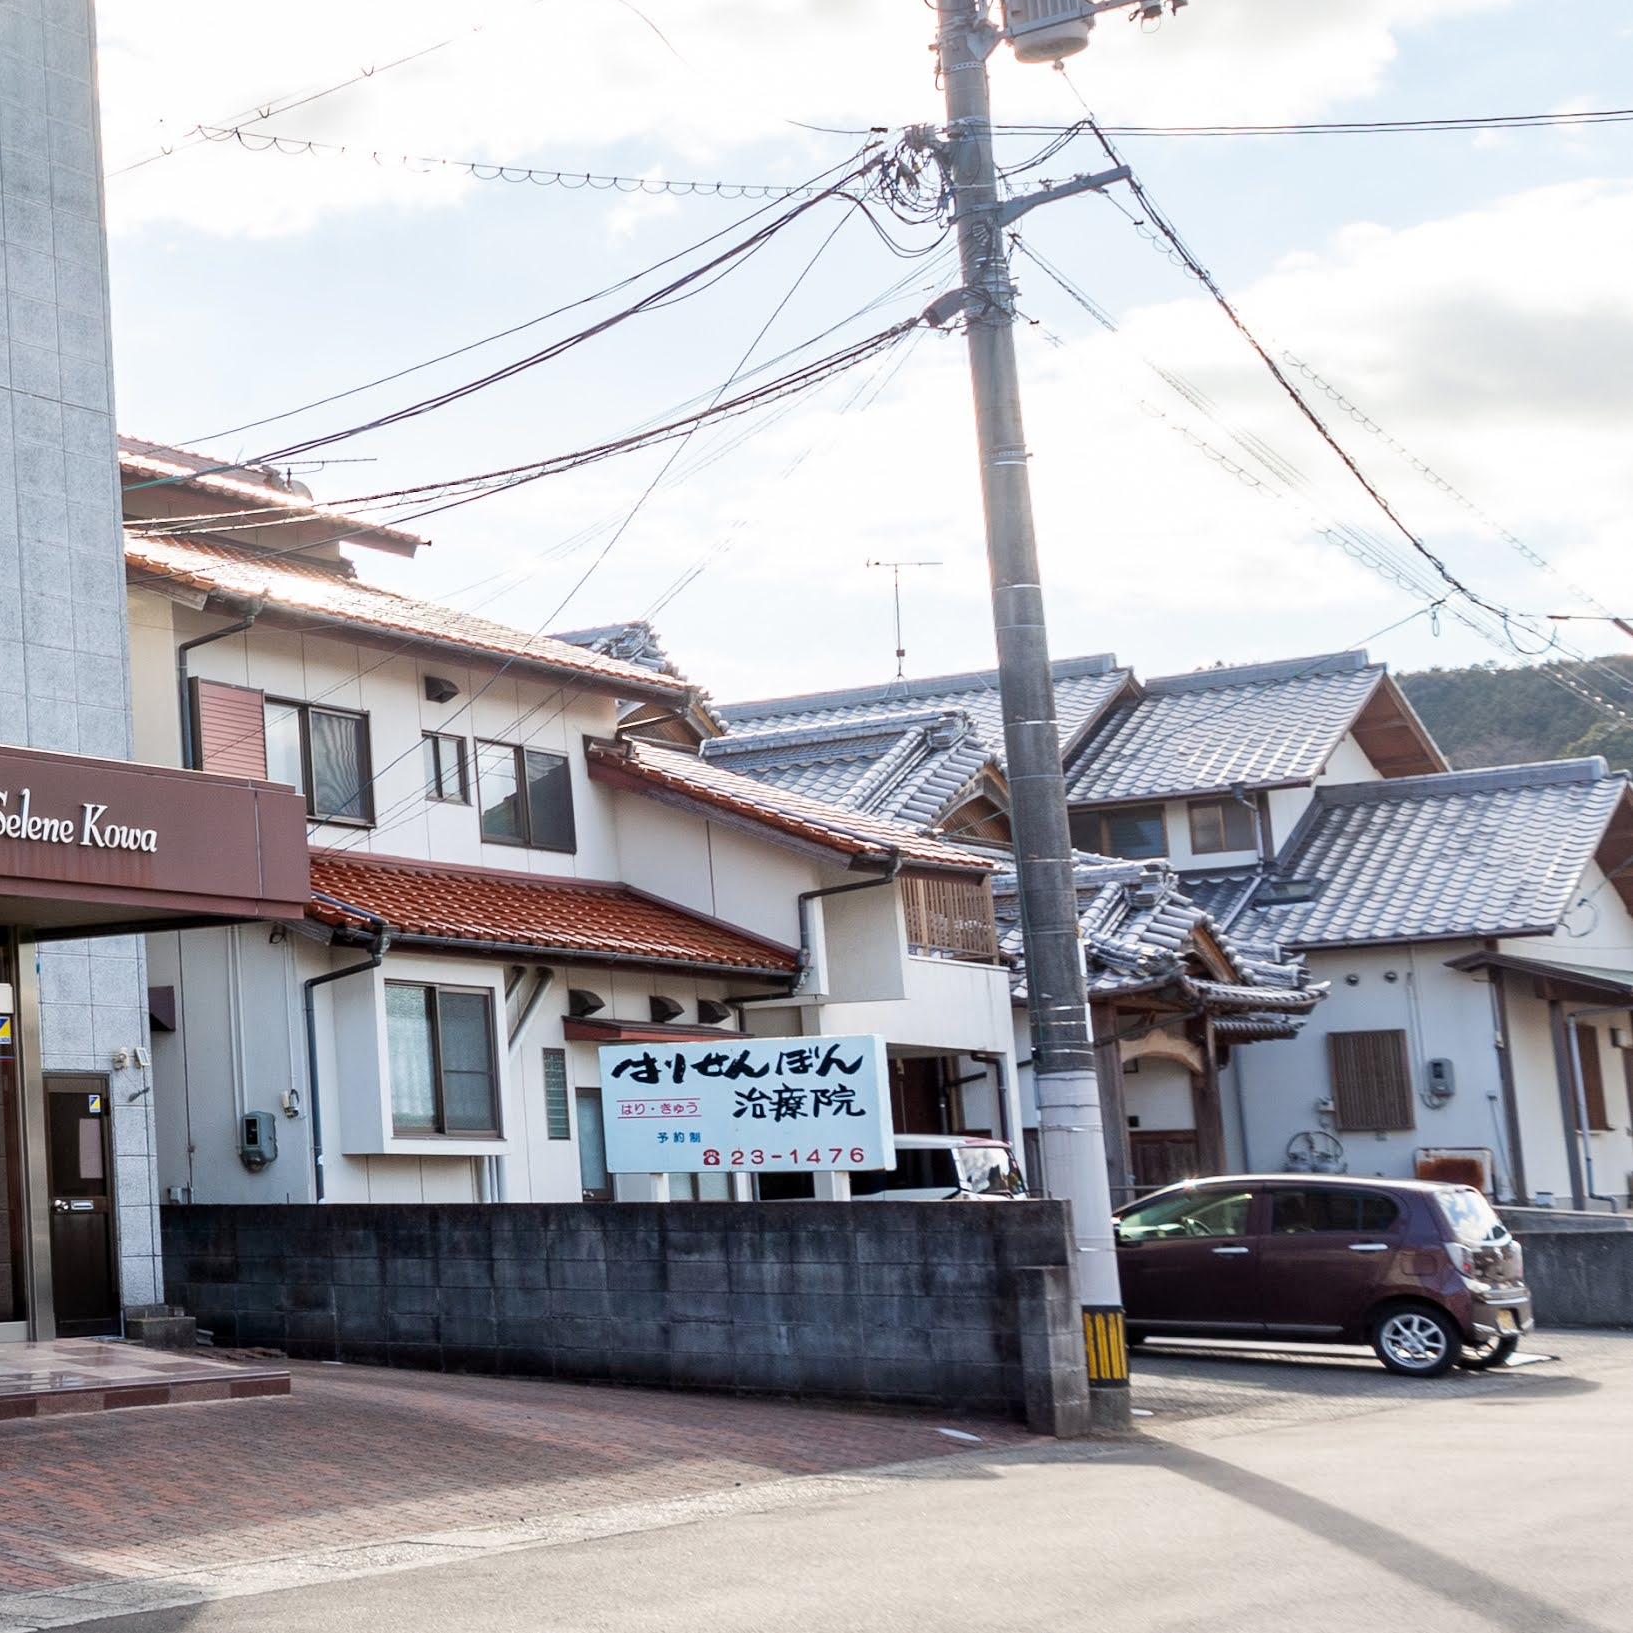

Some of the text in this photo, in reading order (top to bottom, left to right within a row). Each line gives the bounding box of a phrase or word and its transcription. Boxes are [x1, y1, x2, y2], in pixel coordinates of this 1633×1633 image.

[79, 803, 158, 853] Kowa
[611, 1043, 863, 1084] はりせんぼん
[621, 1101, 700, 1116] はり・きゅう
[733, 1083, 866, 1122] 治療院
[657, 1131, 702, 1144] 予約制
[730, 1147, 866, 1166] 23-1476
